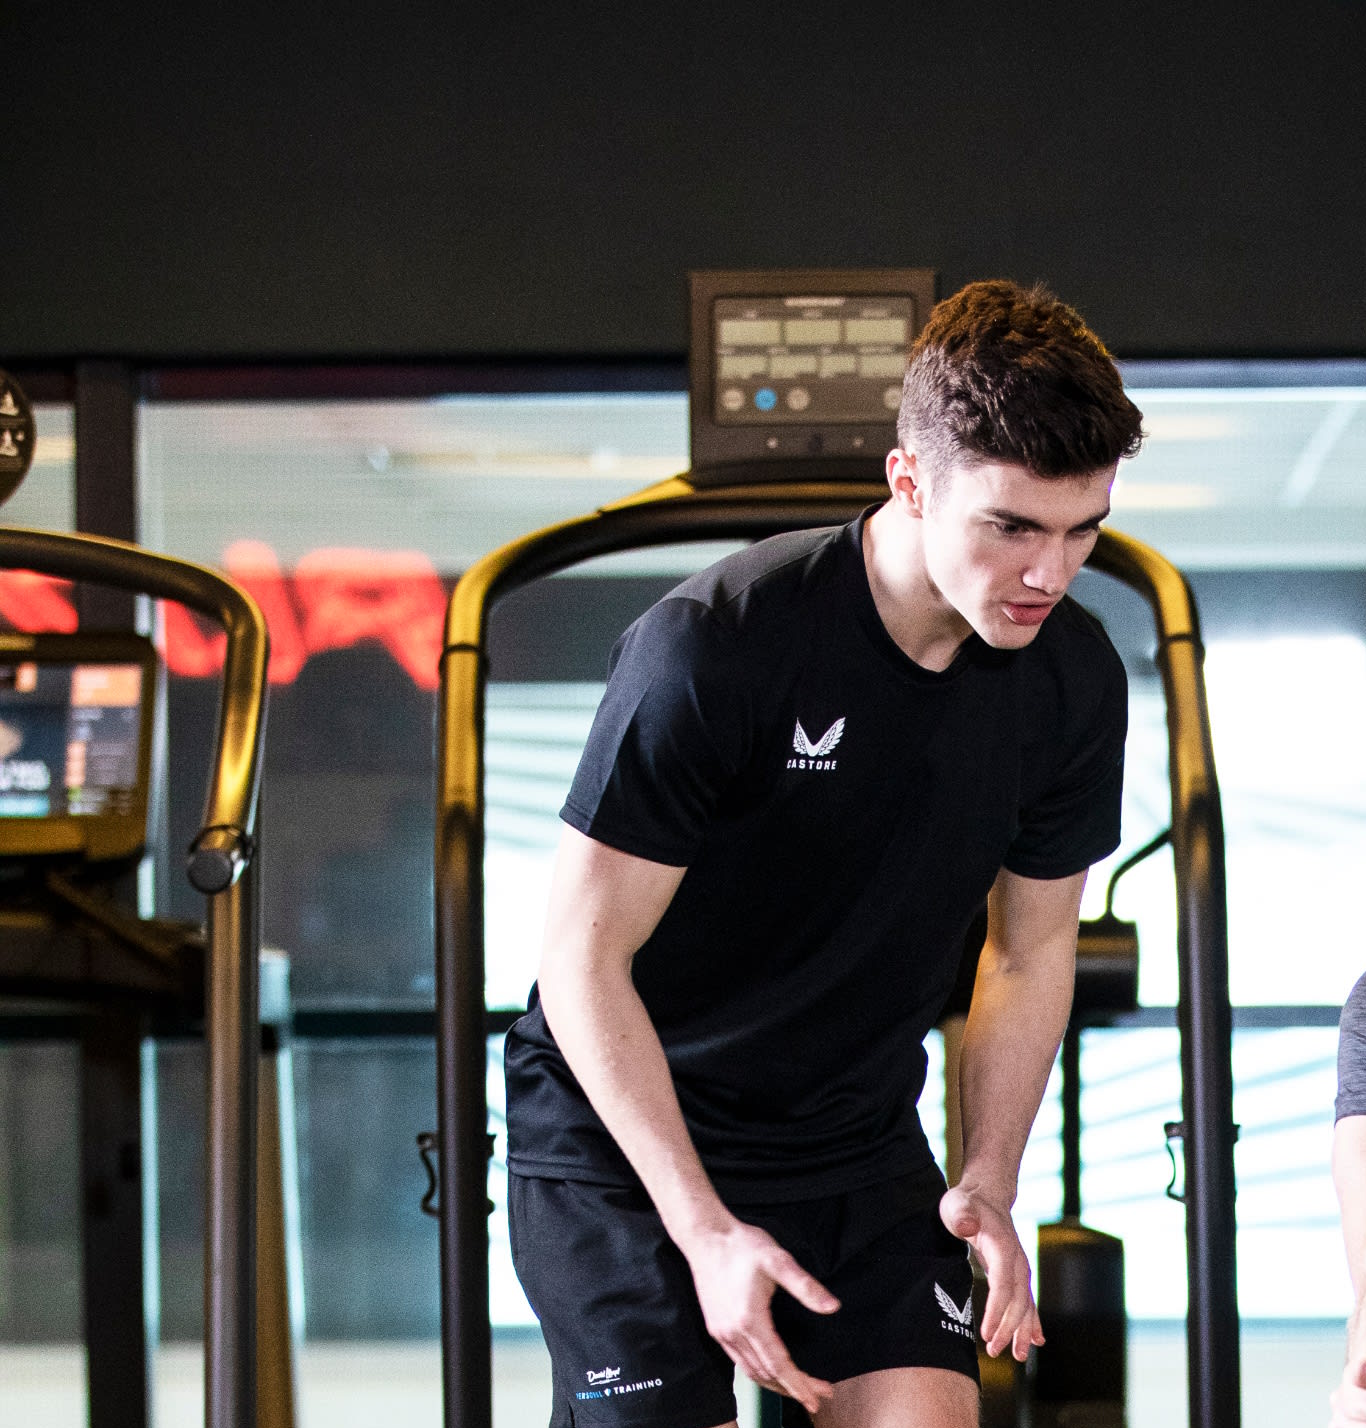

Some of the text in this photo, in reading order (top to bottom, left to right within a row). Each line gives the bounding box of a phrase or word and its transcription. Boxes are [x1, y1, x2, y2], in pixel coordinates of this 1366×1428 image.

[786, 759, 837, 770] CASTORE
[941, 1320, 976, 1342] CASTO
[613, 1378, 663, 1395] TRAINING
